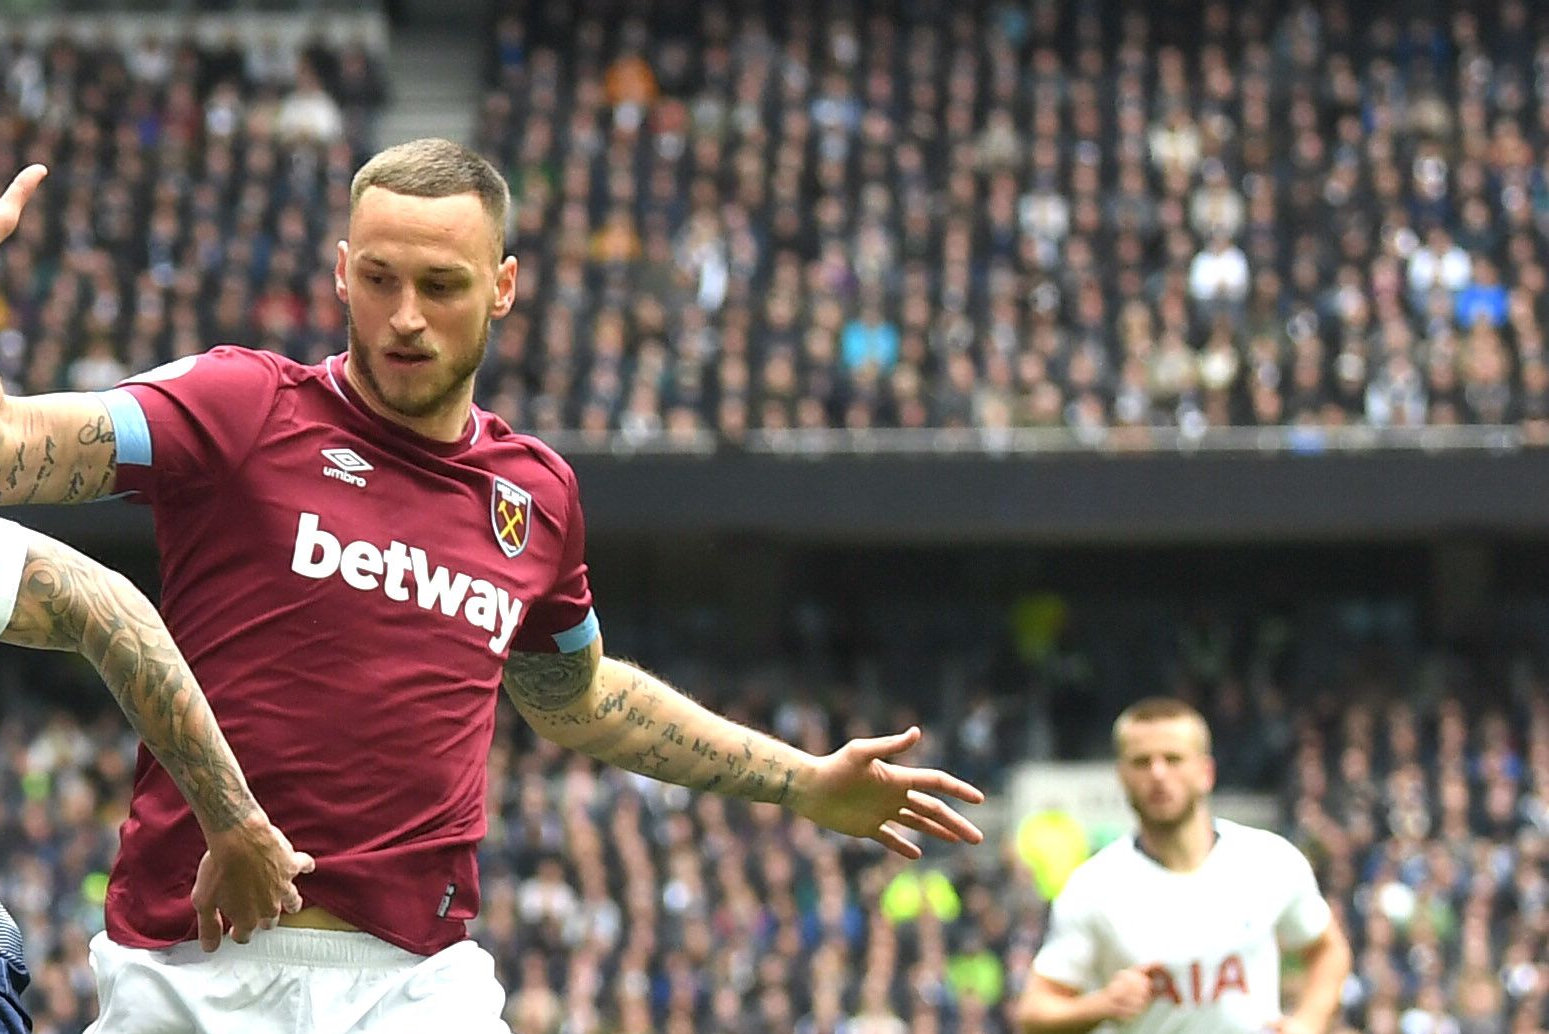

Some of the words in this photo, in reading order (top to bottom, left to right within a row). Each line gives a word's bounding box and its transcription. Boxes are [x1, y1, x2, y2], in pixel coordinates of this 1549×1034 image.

[323, 466, 367, 488] umbro
[291, 511, 523, 655] betway
[1145, 953, 1250, 1006] AIA
